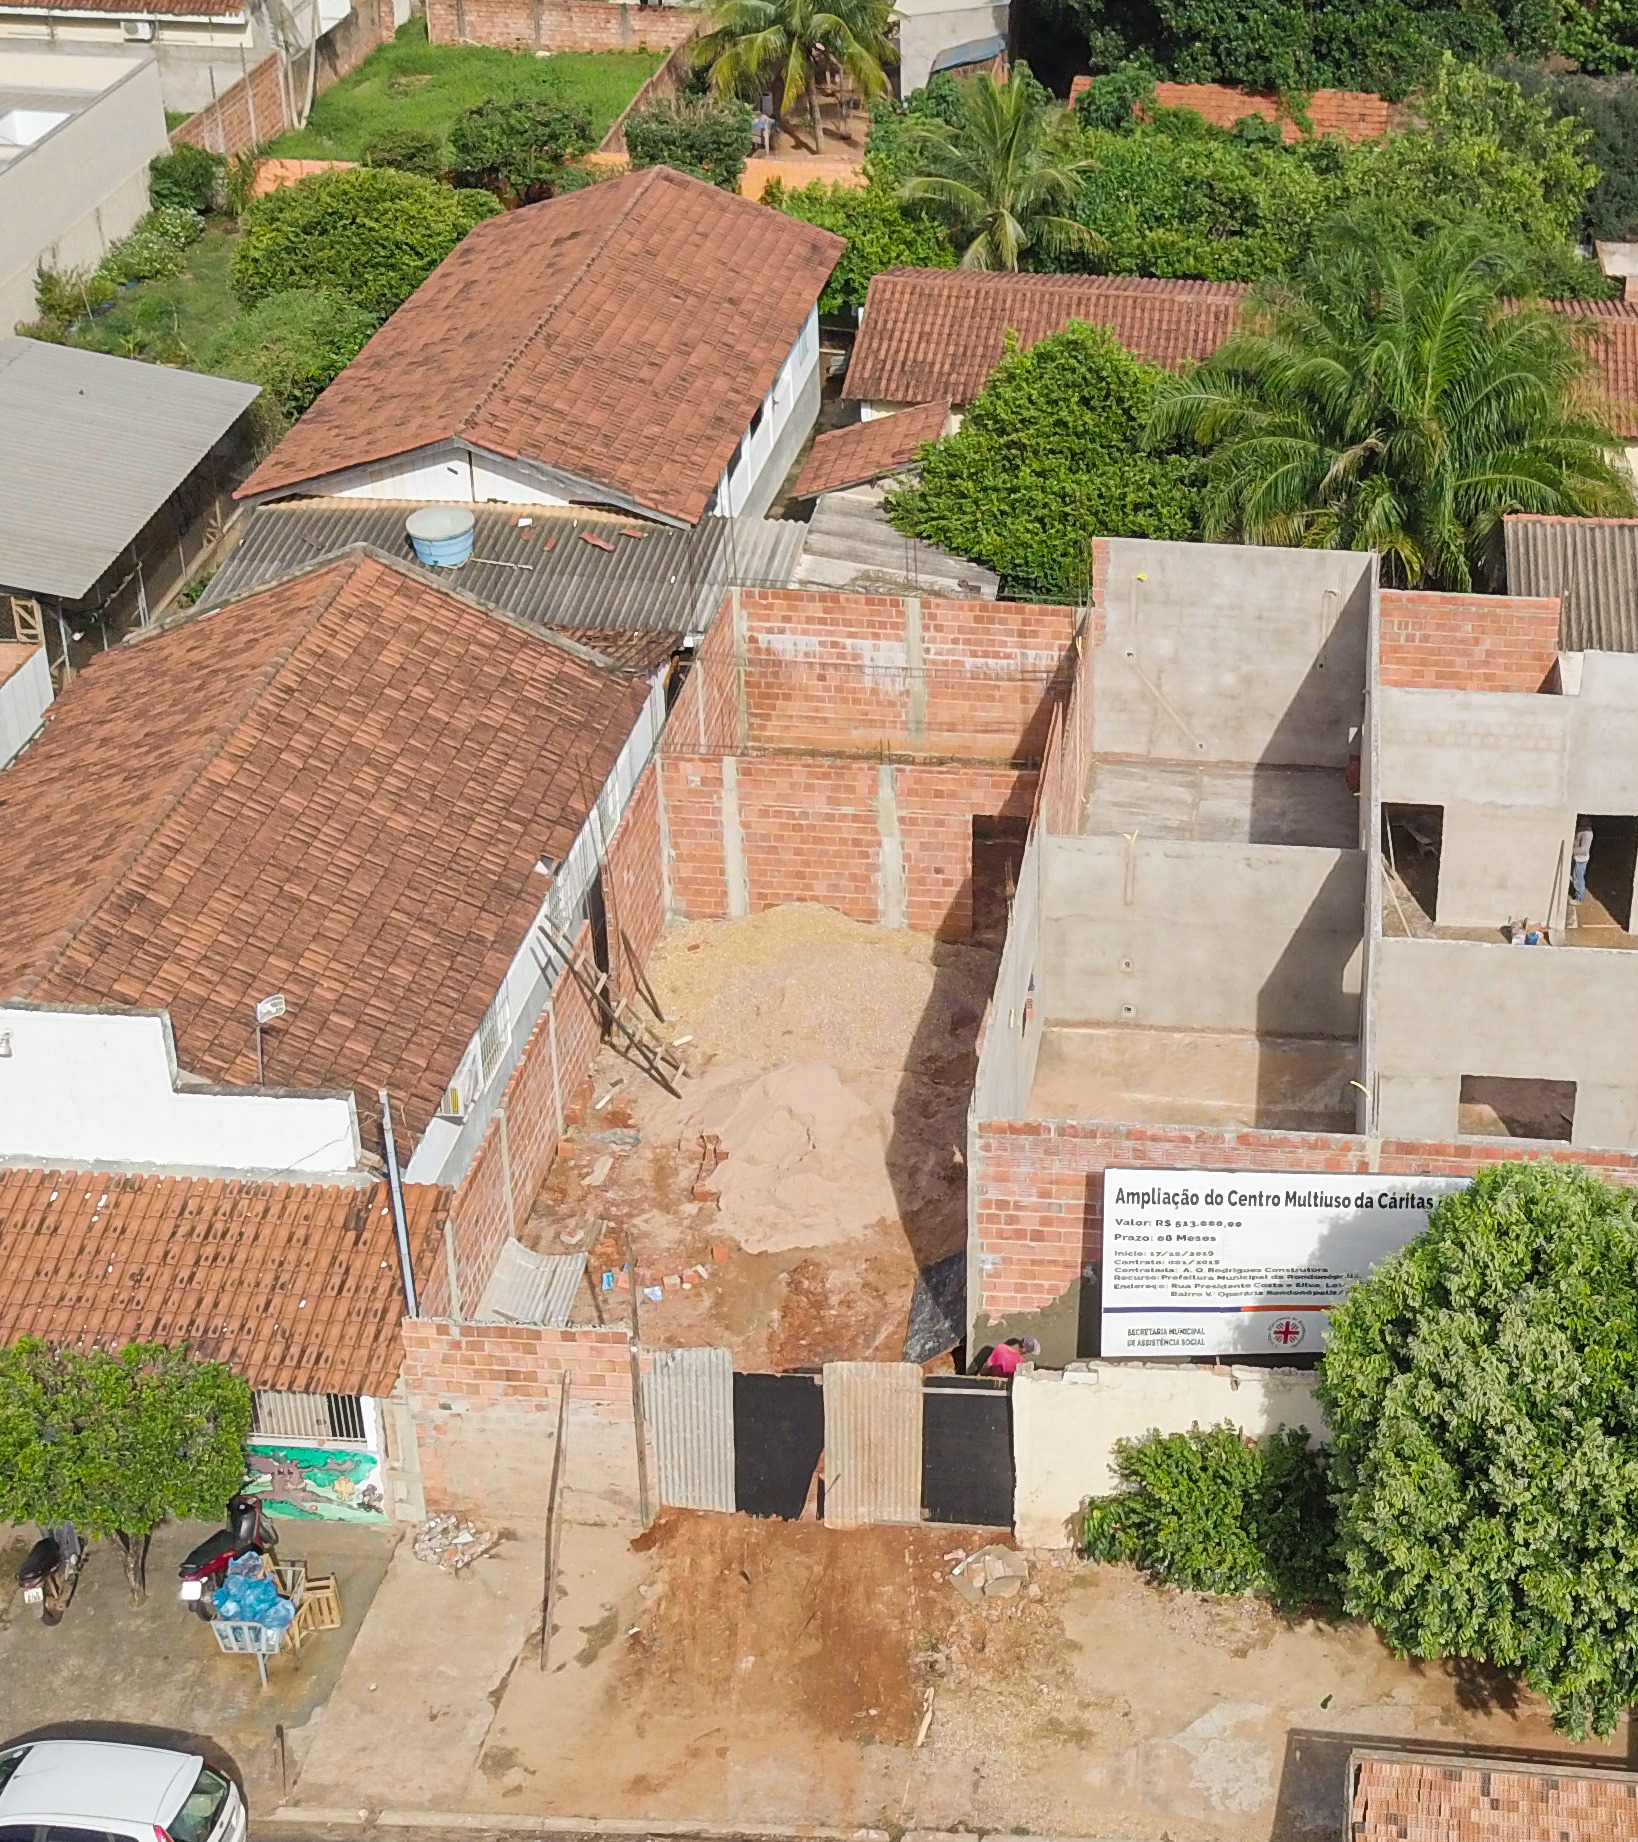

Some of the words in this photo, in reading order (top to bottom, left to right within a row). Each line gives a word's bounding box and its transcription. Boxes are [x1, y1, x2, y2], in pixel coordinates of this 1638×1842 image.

[1115, 1187, 1199, 1209] Ampliação
[1205, 1189, 1223, 1206] do
[1228, 1190, 1280, 1207] Centro
[1285, 1191, 1350, 1208] Multiuso
[1354, 1192, 1374, 1208] da
[1378, 1192, 1433, 1209] Cáritas
[1115, 1219, 1151, 1227] Valor:
[1156, 1219, 1171, 1227] R$
[1114, 1233, 1153, 1242] Prazo:
[1176, 1234, 1216, 1242] Meses
[1127, 1328, 1167, 1336] SECRETARIA
